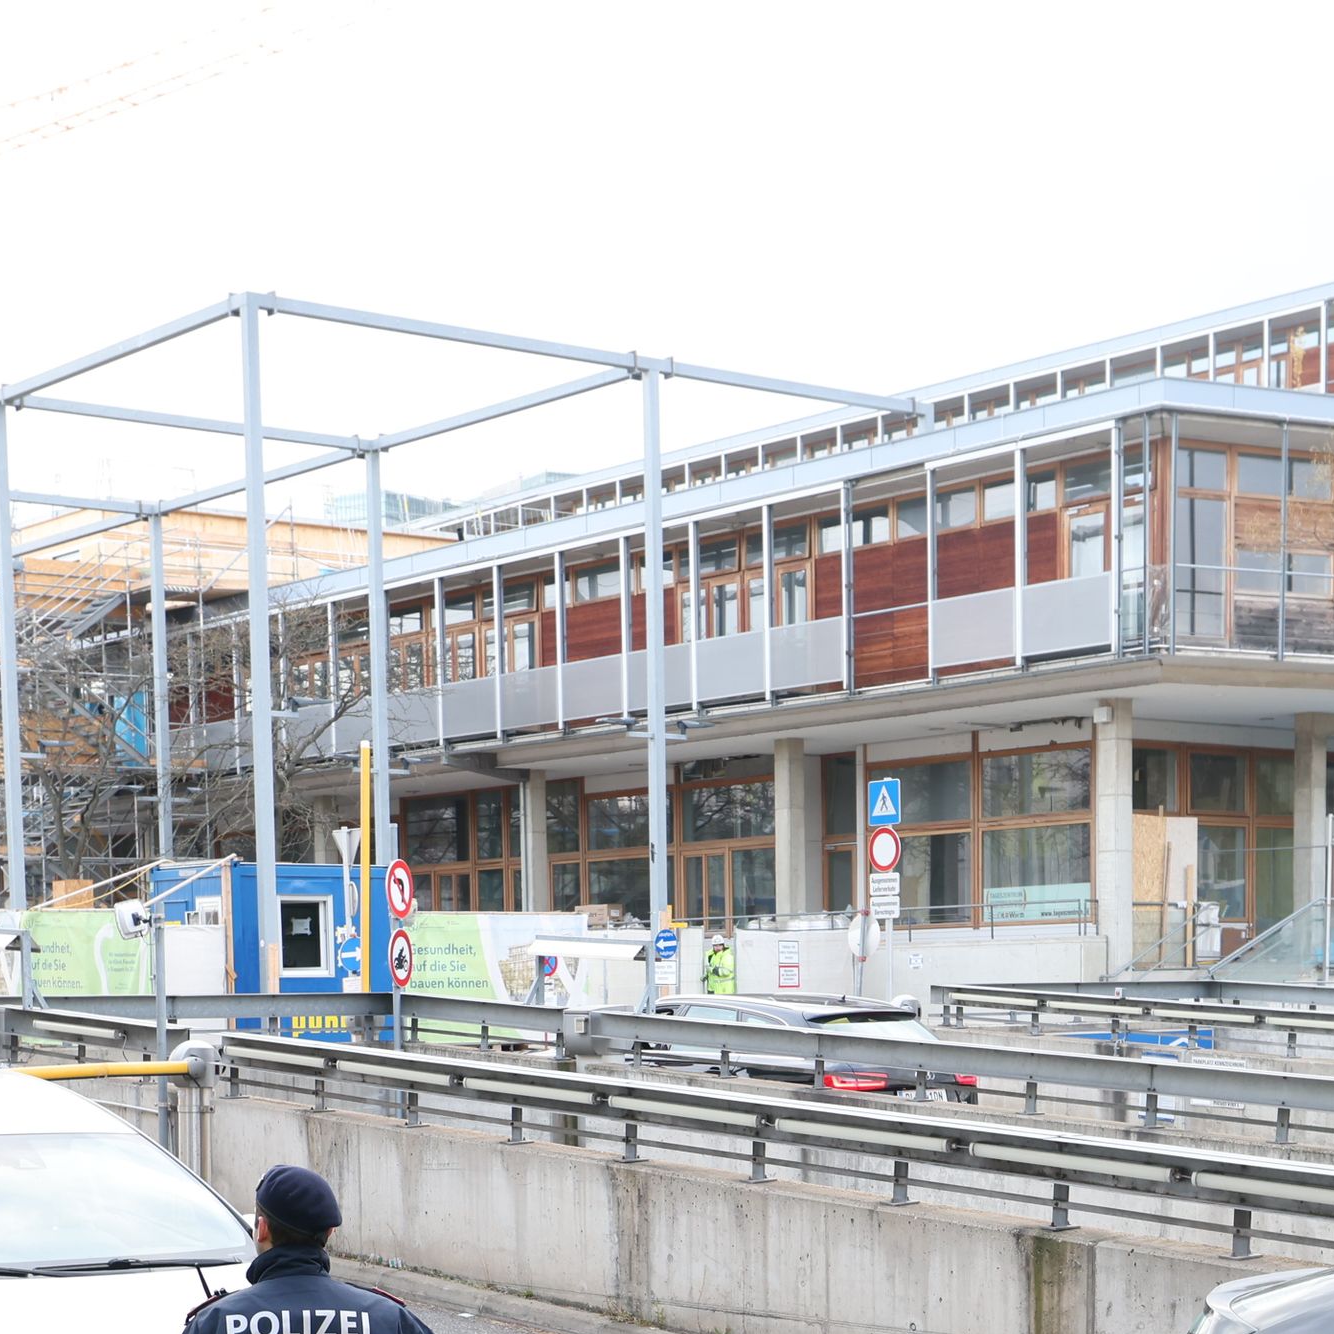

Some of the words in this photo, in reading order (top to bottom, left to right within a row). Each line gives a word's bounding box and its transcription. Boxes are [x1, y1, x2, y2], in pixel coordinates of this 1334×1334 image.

[54, 958, 67, 971] Sie
[430, 960, 447, 972] die
[449, 960, 467, 972] Sie
[410, 977, 445, 989] bauen
[447, 976, 489, 989] können
